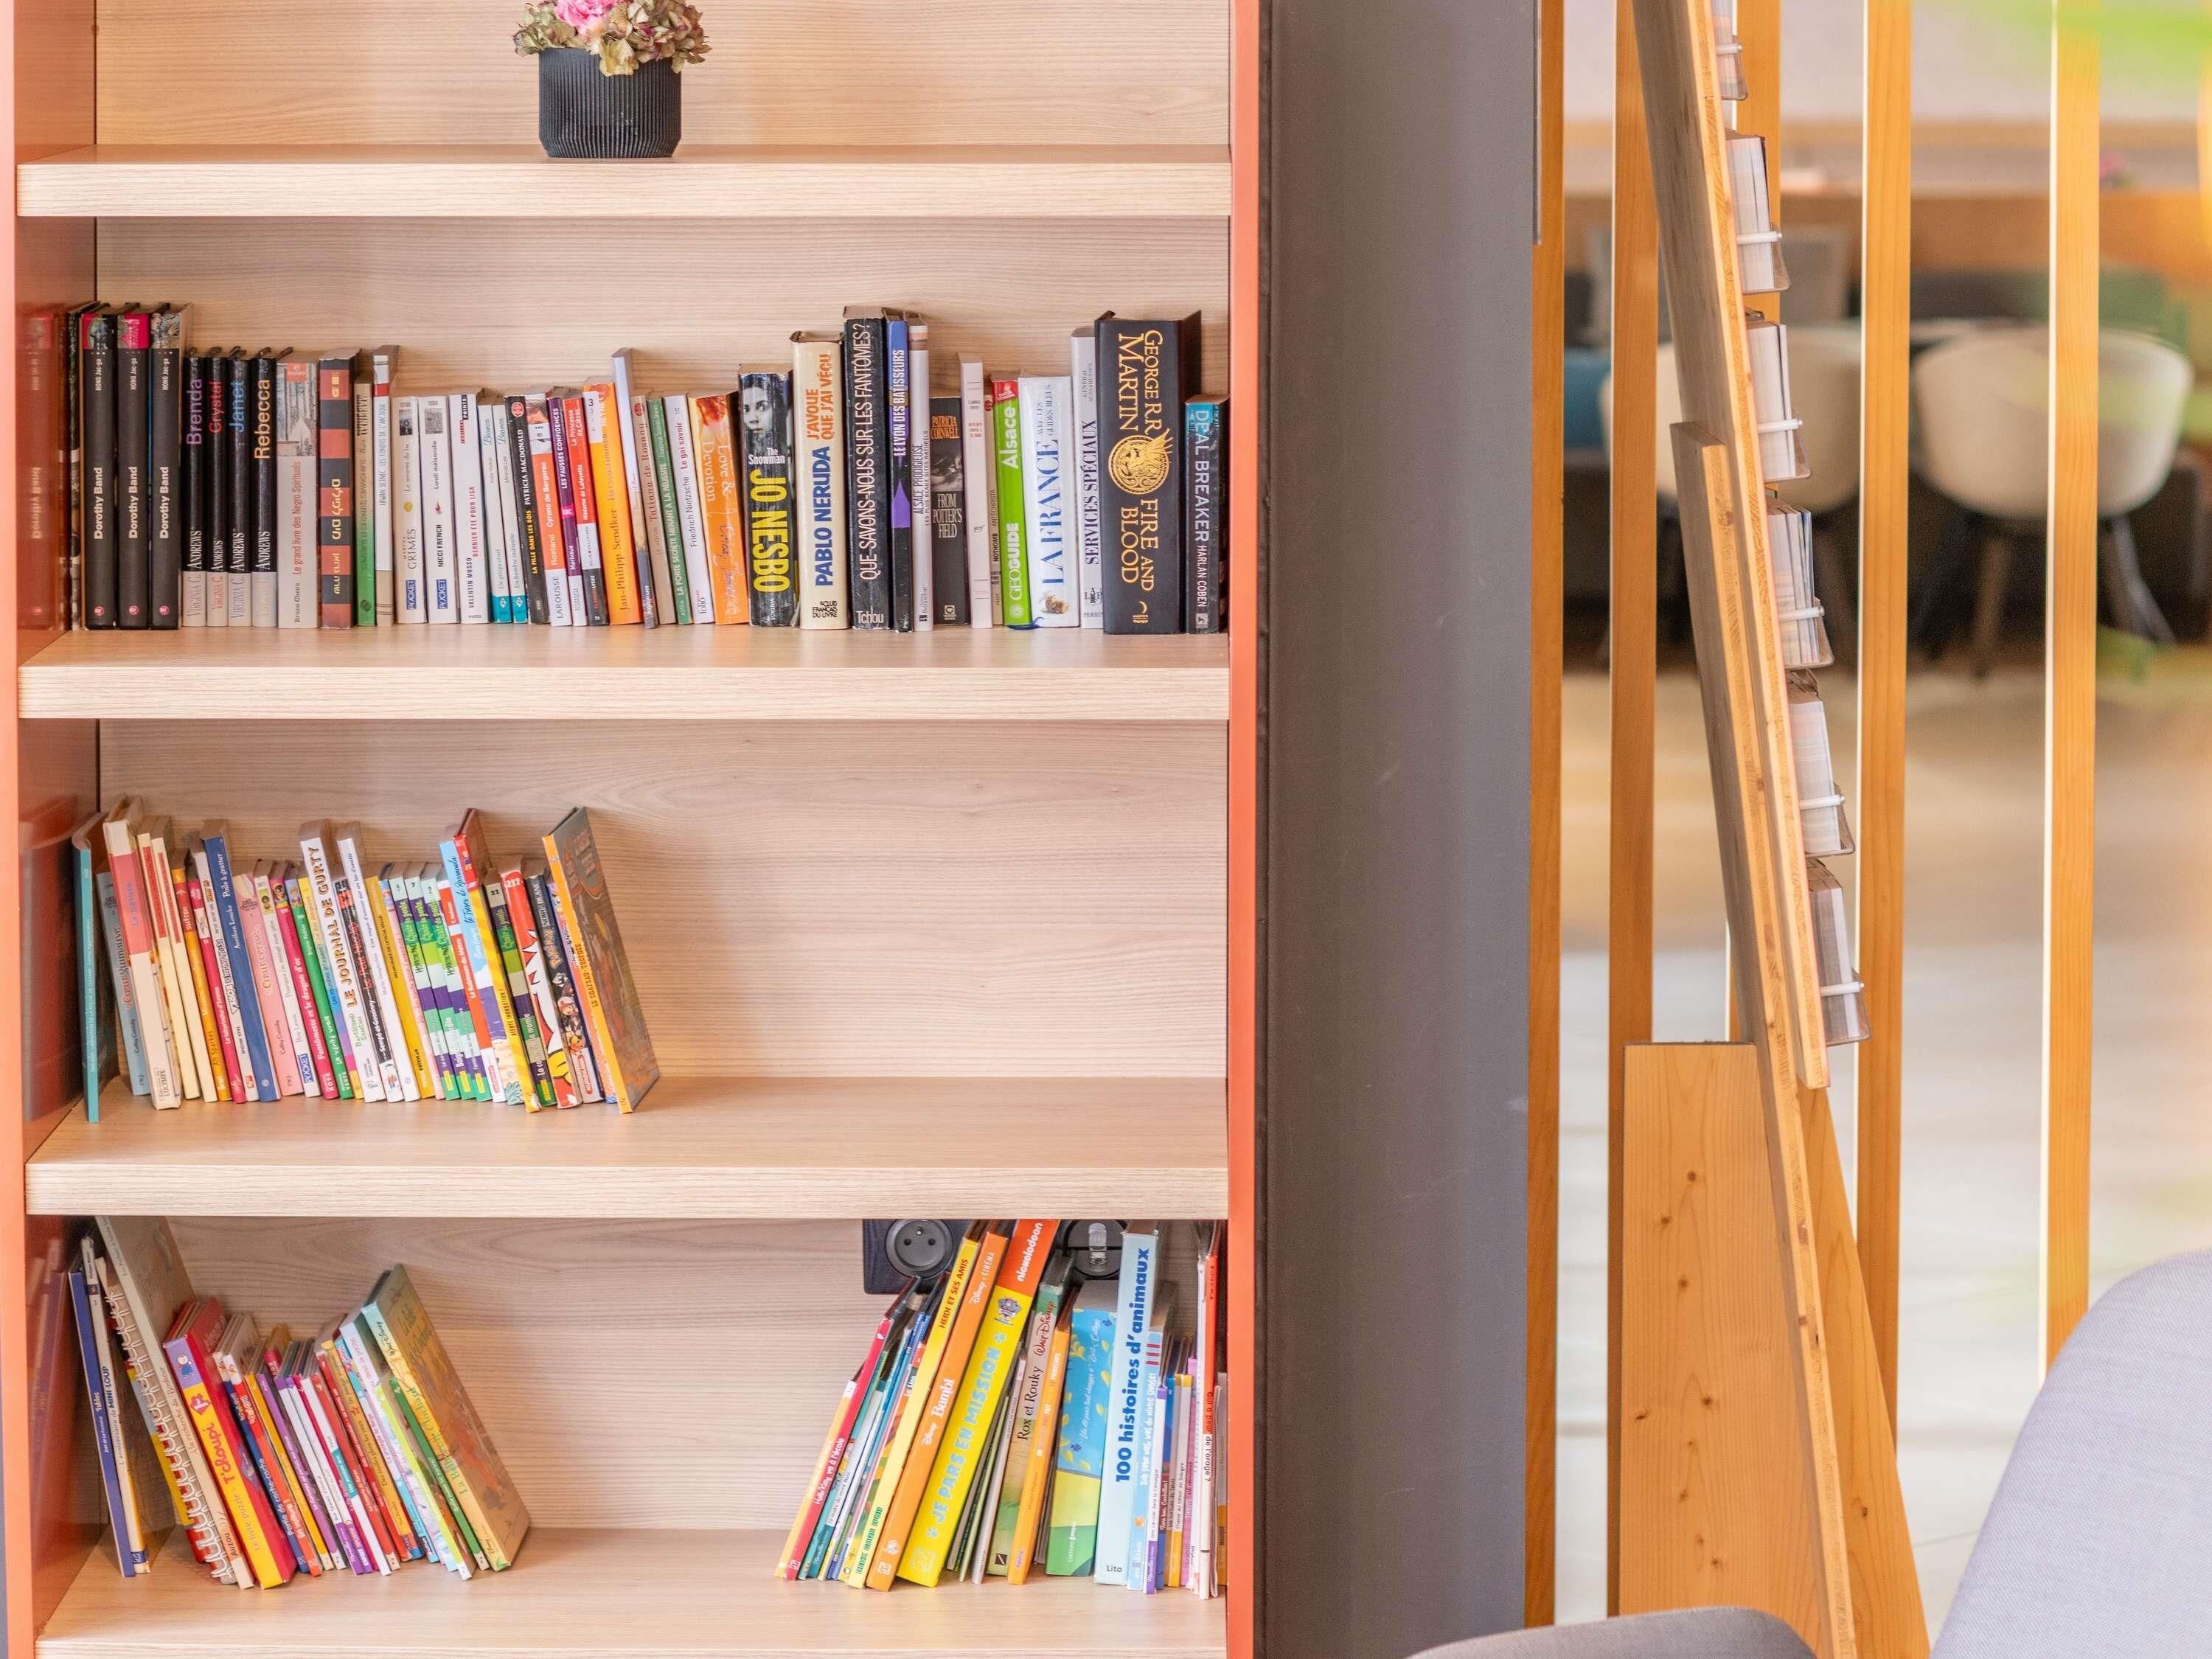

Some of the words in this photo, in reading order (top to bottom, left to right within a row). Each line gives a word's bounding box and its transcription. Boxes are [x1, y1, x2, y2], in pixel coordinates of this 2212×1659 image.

[817, 353, 833, 389] VÉCU
[1144, 330, 1164, 400] GEORGE
[1118, 333, 1145, 432] MARTIN
[186, 378, 203, 445] Brenda
[209, 380, 223, 434] Crystal
[229, 380, 246, 433] Janet
[805, 389, 820, 440] J'AVOUE
[820, 390, 835, 412] J'AI
[855, 401, 874, 425] LES
[892, 405, 905, 422] DES
[254, 379, 271, 459] Rebecca
[553, 408, 564, 451] CONFIDENCES
[820, 415, 835, 440] QUE
[674, 422, 684, 445] savoir
[855, 428, 874, 455] SUR
[892, 423, 906, 446] LYON
[998, 406, 1020, 470] Alsace
[1194, 410, 1210, 456] DEAL
[517, 429, 528, 473] MACDONALD
[557, 451, 566, 478] FAUSSES
[717, 444, 731, 477] Love
[766, 447, 779, 456] The
[893, 447, 906, 456] LE
[1079, 419, 1098, 491] SPÉCIAUX
[92, 467, 104, 495] Band
[128, 466, 139, 493] Band
[159, 466, 170, 493] Band
[291, 462, 303, 493] Spirituals
[701, 442, 717, 502] Devotion
[749, 468, 787, 503] JO
[811, 446, 832, 523] NERUDA
[521, 474, 531, 505] PATRICIA
[664, 493, 672, 501] LA
[682, 476, 693, 513] Nietzsche
[913, 489, 925, 515] ALSACE
[1036, 439, 1062, 543] FRANCE
[1194, 460, 1210, 543] BREAKER
[92, 495, 105, 540] Dorothy
[128, 495, 139, 539] Dorothy
[159, 495, 171, 539] Dorothy
[293, 495, 303, 514] Negro
[546, 504, 554, 527] Cyrano
[855, 459, 877, 549] SAVONS-NOUS
[292, 516, 301, 529] des
[609, 509, 622, 550] Sendker
[667, 509, 677, 536] MENANT
[688, 515, 698, 547] Friedrich
[1082, 495, 1100, 565] SERVICES
[1140, 498, 1159, 550] FIRE
[187, 530, 202, 569] ANDREWS
[292, 530, 302, 544] livre
[406, 528, 417, 570] GRIMES
[436, 524, 444, 549] FRENCH
[549, 534, 558, 566] Rostand
[991, 532, 999, 562] NOTHOMB
[1120, 506, 1140, 584] BLOOD
[211, 540, 223, 571] ANDREWS
[229, 532, 245, 571] ANDREWS
[254, 531, 271, 570] ANDREWS
[293, 546, 303, 565] grand
[568, 545, 577, 571] Marivaux
[751, 510, 790, 592] NESBO
[813, 526, 834, 587] PABLO
[1006, 522, 1023, 601] GEOGUIDE
[1197, 545, 1208, 578] HARLAN
[465, 557, 473, 578] MUSSO
[675, 564, 684, 585] PORTE
[858, 553, 881, 580] QUE
[1040, 549, 1064, 584] LA
[1140, 555, 1155, 592] AND
[466, 580, 475, 608] VALENTIN
[613, 553, 630, 611] Jan-Philipp
[1197, 580, 1208, 608] COBEN
[187, 586, 201, 617] VIRGINIA
[229, 585, 245, 619] VIRGINIA
[552, 577, 564, 619] LAROUSSE
[855, 611, 885, 625] Tchou
[216, 852, 230, 875] gratter
[307, 846, 330, 895] GURTY
[222, 880, 232, 897] Poils
[321, 898, 334, 918] DE
[456, 937, 465, 956] Métro
[503, 928, 515, 949] Chair
[293, 957, 305, 973] d'or
[327, 919, 352, 986] JOURNAL
[298, 974, 312, 1001] dragon
[464, 966, 475, 992] Robinson
[305, 1001, 313, 1009] le
[344, 989, 358, 1008] LE
[324, 1015, 334, 1034] vraie
[329, 1035, 339, 1055] vérité
[298, 1053, 314, 1083] POCKET
[324, 1073, 334, 1091] ROSE
[955, 1258, 969, 1280] AMIS
[946, 1296, 956, 1306] ET
[950, 1281, 961, 1295] SES
[968, 1281, 987, 1304] Disney
[1125, 1248, 1150, 1355] d'animaux
[938, 1307, 955, 1329] HEIDI
[158, 1366, 175, 1395] Bonheur
[961, 1346, 1002, 1425] MISSION
[1023, 1366, 1044, 1402] Rouky
[1145, 1373, 1158, 1396] siehst!
[171, 1398, 179, 1407] du
[406, 1385, 435, 1432] Clochard
[929, 1378, 956, 1419] Bambi
[1118, 1358, 1141, 1442] histoires
[1145, 1397, 1155, 1416] nicht
[1206, 1391, 1214, 1401] Qui
[1023, 1405, 1034, 1416] et
[1144, 1417, 1152, 1427] du
[1203, 1413, 1213, 1433] peur
[175, 1408, 192, 1441] recherche
[357, 1420, 369, 1433] yeux
[922, 1422, 939, 1447] Disney
[955, 1424, 974, 1449] EN
[1016, 1419, 1033, 1441] Rox
[111, 1420, 125, 1466] L'anniversaire
[202, 1422, 236, 1485] T'choupi
[366, 1441, 380, 1456] plein
[827, 1438, 846, 1460] l'école
[1205, 1436, 1212, 1446] de
[824, 1466, 835, 1476] va
[937, 1451, 965, 1499] PARS
[1115, 1447, 1131, 1483] 100
[1202, 1447, 1213, 1476] l'orage
[233, 1493, 251, 1520] puzzle
[278, 1505, 288, 1515] de
[813, 1489, 827, 1505] Hello
[286, 1503, 302, 1528] voiture
[930, 1500, 949, 1524] JE
[245, 1522, 258, 1540] livre
[281, 1517, 295, 1536] Partie
[295, 1528, 306, 1539] En
[1106, 1565, 1123, 1573] Lito
